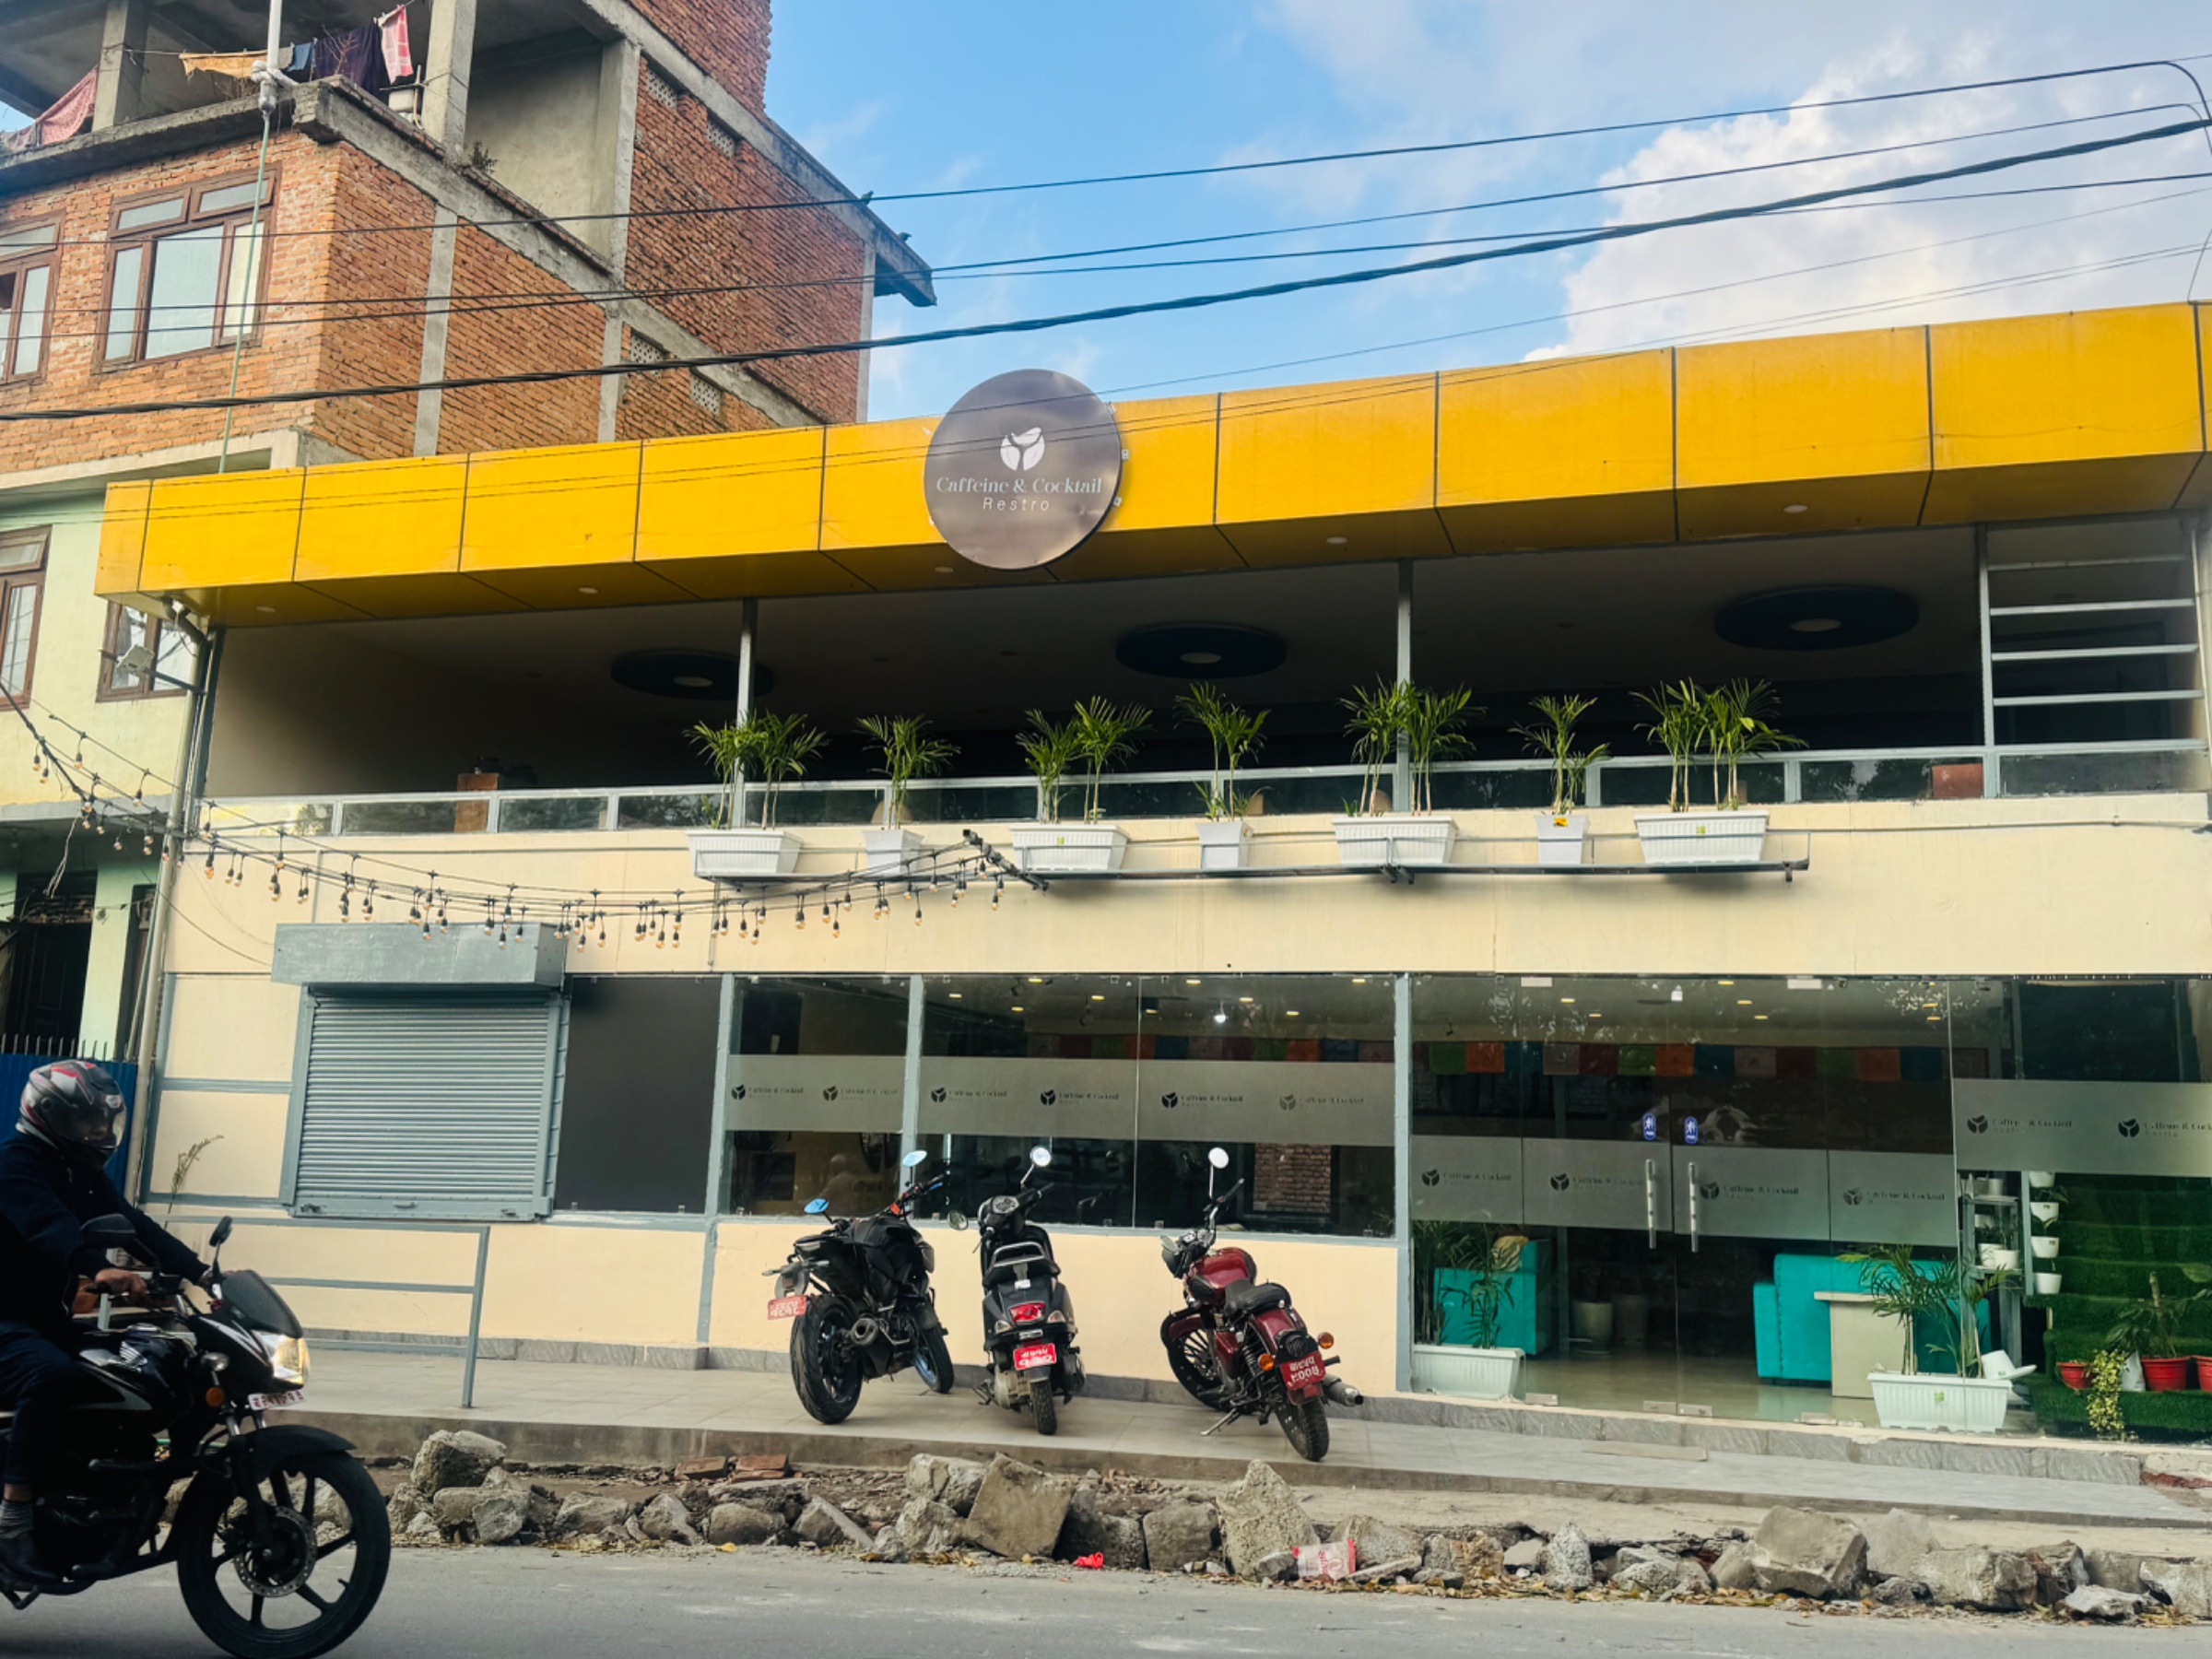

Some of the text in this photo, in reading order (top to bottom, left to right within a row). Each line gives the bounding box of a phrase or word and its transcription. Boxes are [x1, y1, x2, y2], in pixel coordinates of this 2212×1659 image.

[935, 476, 1102, 494] Caffeine & Cocktail
[982, 497, 1050, 512] Restro
